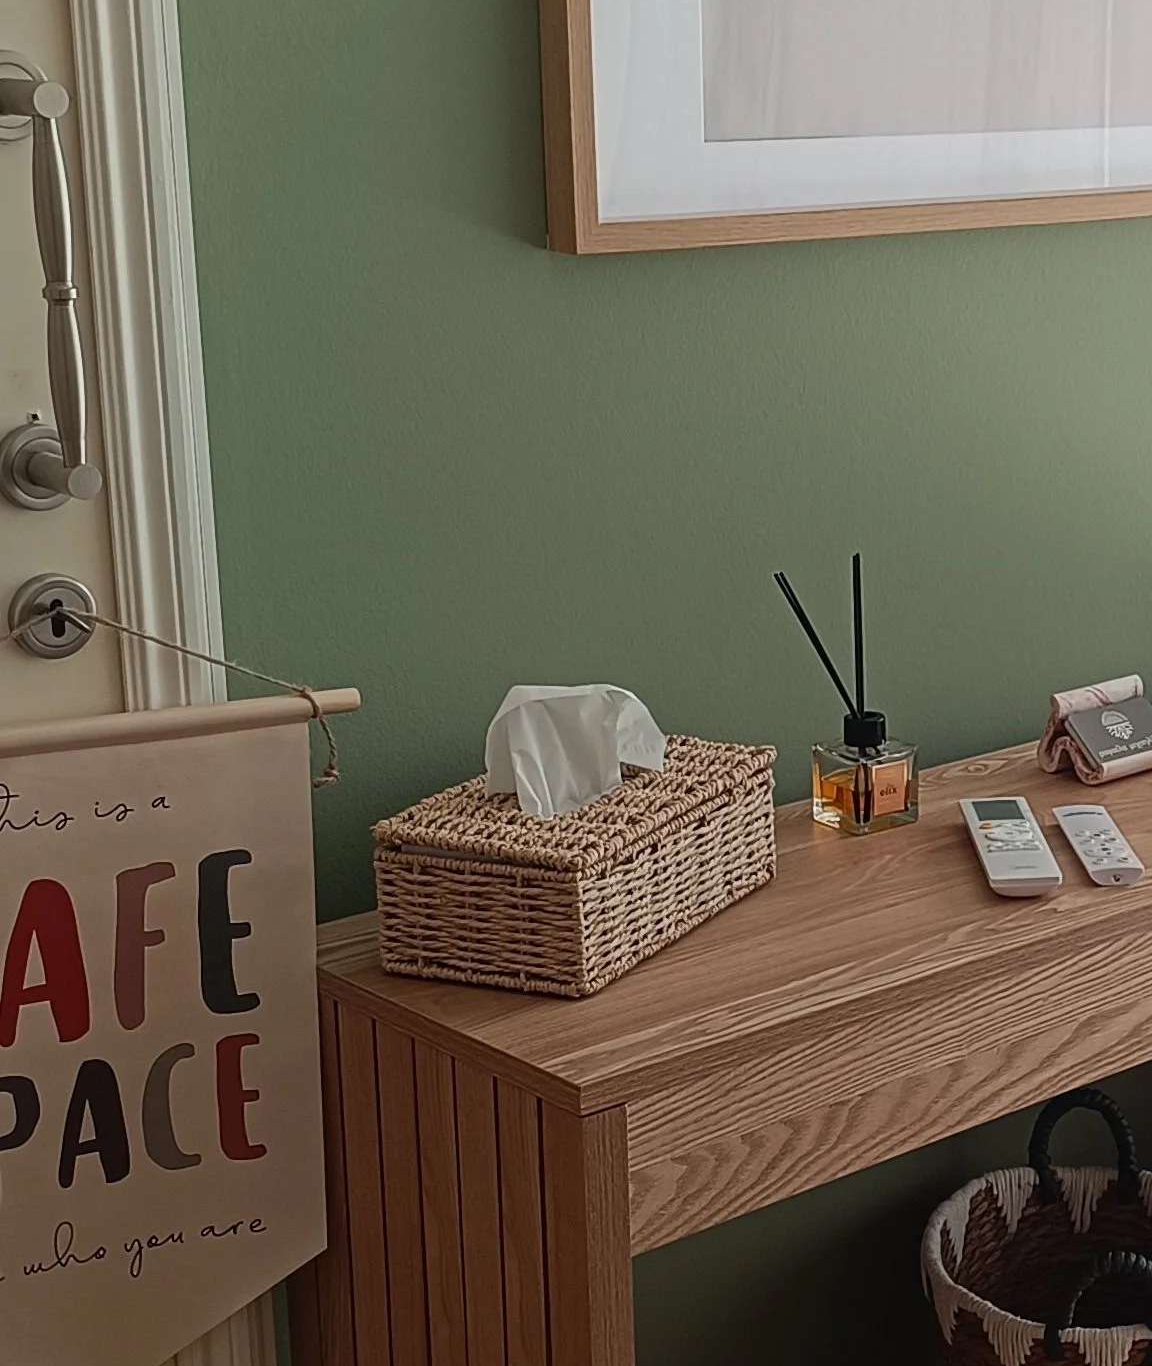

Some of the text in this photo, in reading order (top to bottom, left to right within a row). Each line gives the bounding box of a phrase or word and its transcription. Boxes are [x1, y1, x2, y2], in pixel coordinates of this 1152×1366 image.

[94, 801, 135, 822] is
[151, 795, 171, 809] a
[0, 849, 261, 1048] AFE
[0, 1033, 267, 1189] PACE
[23, 1218, 267, 1278] who you are
